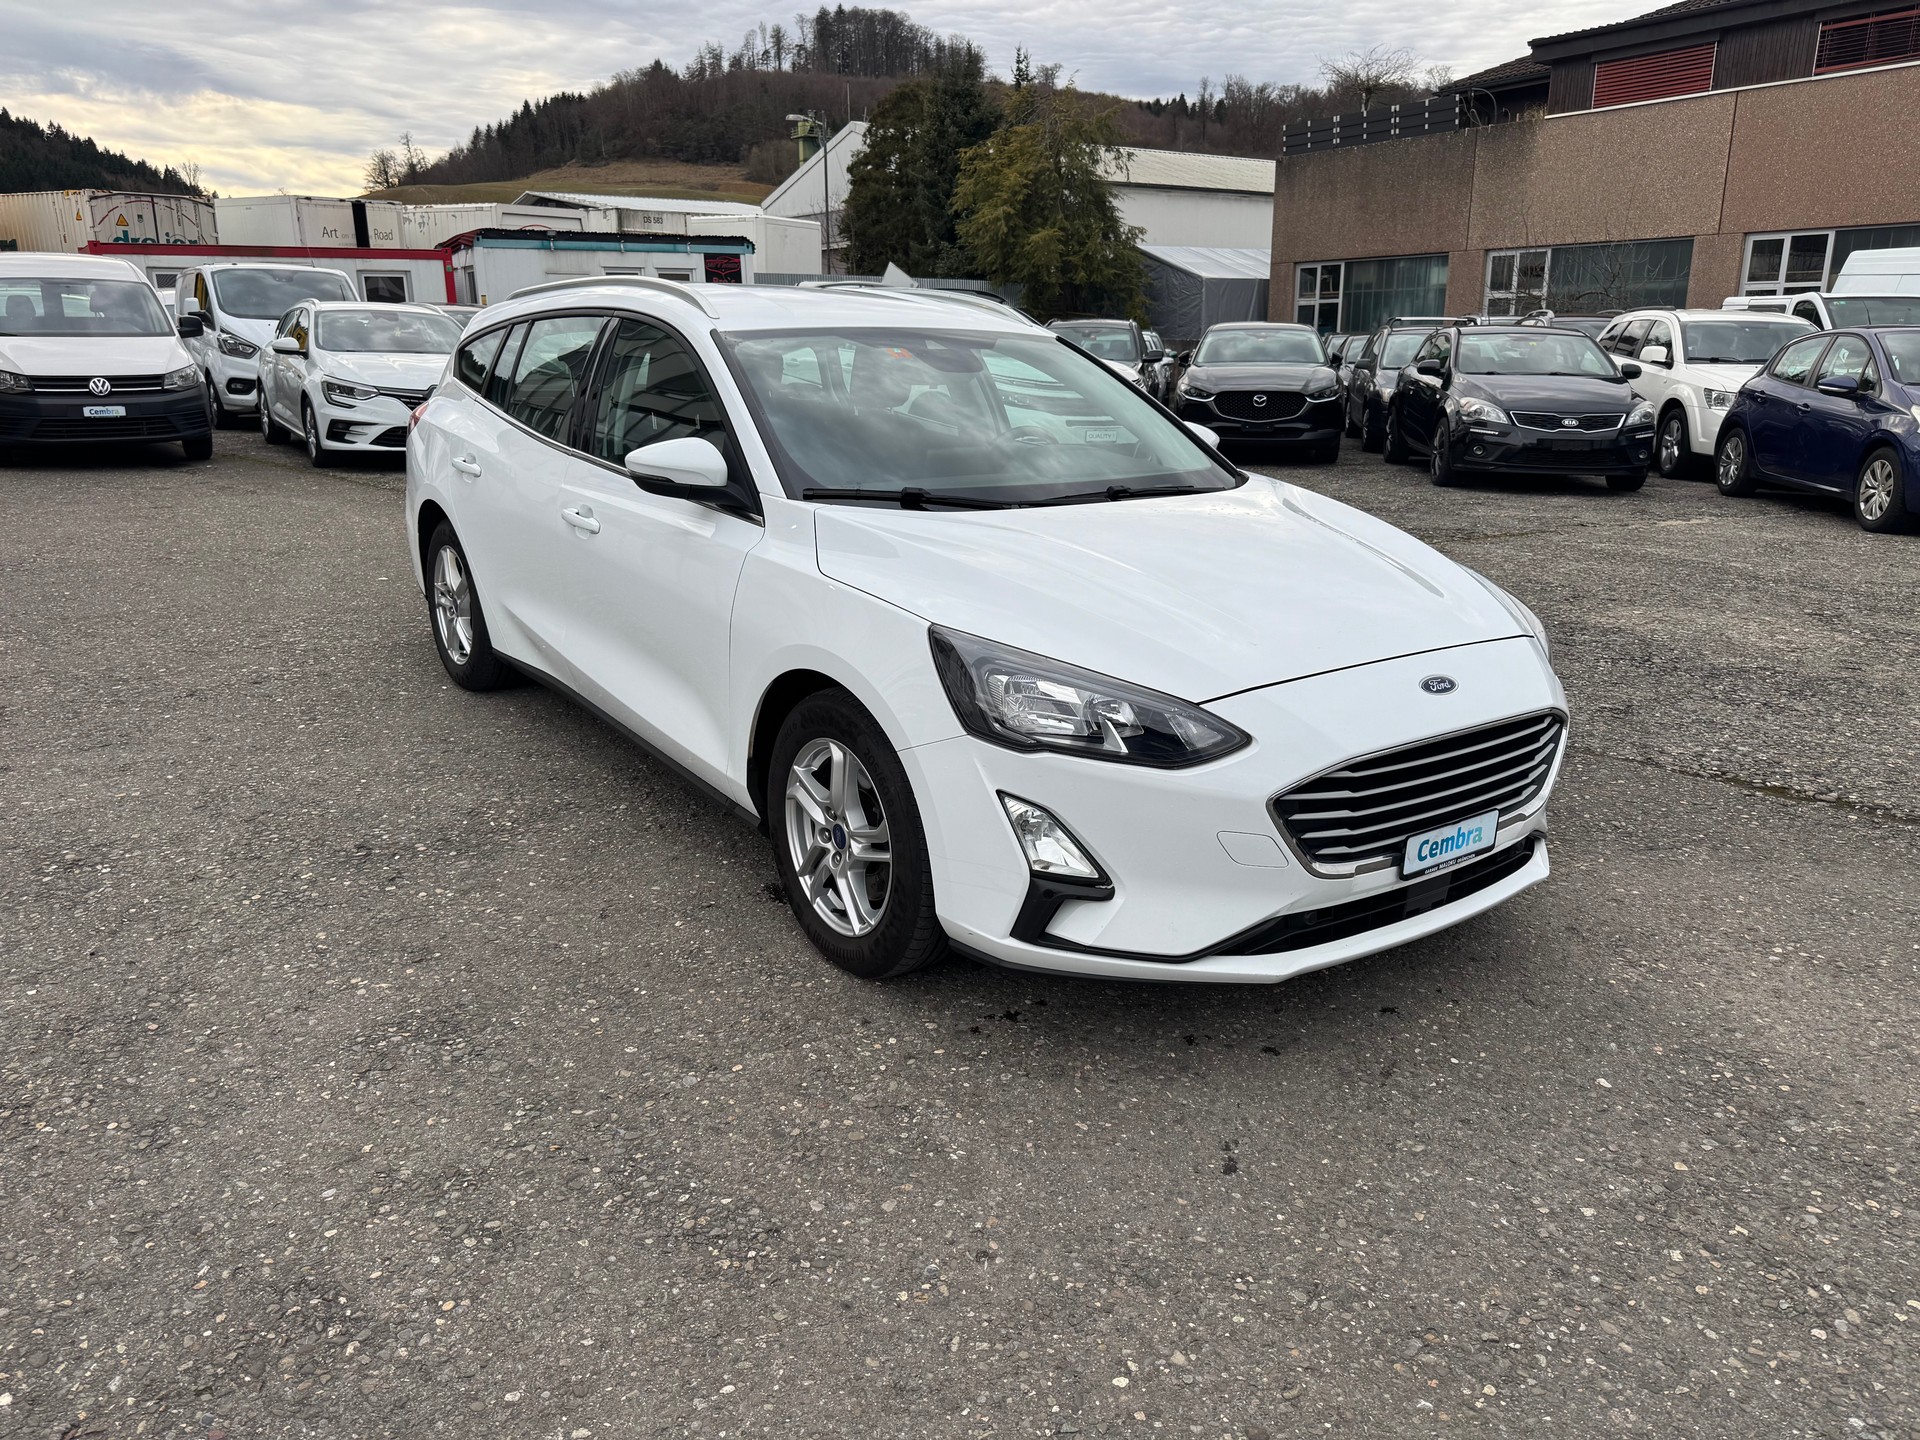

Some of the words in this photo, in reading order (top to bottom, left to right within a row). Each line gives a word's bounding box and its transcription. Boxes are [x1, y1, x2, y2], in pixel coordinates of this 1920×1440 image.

[643, 216, 652, 224] DS
[322, 226, 339, 239] Art
[373, 228, 393, 241] Road
[1428, 678, 1451, 692] Ford
[1417, 826, 1483, 862] Cembra
